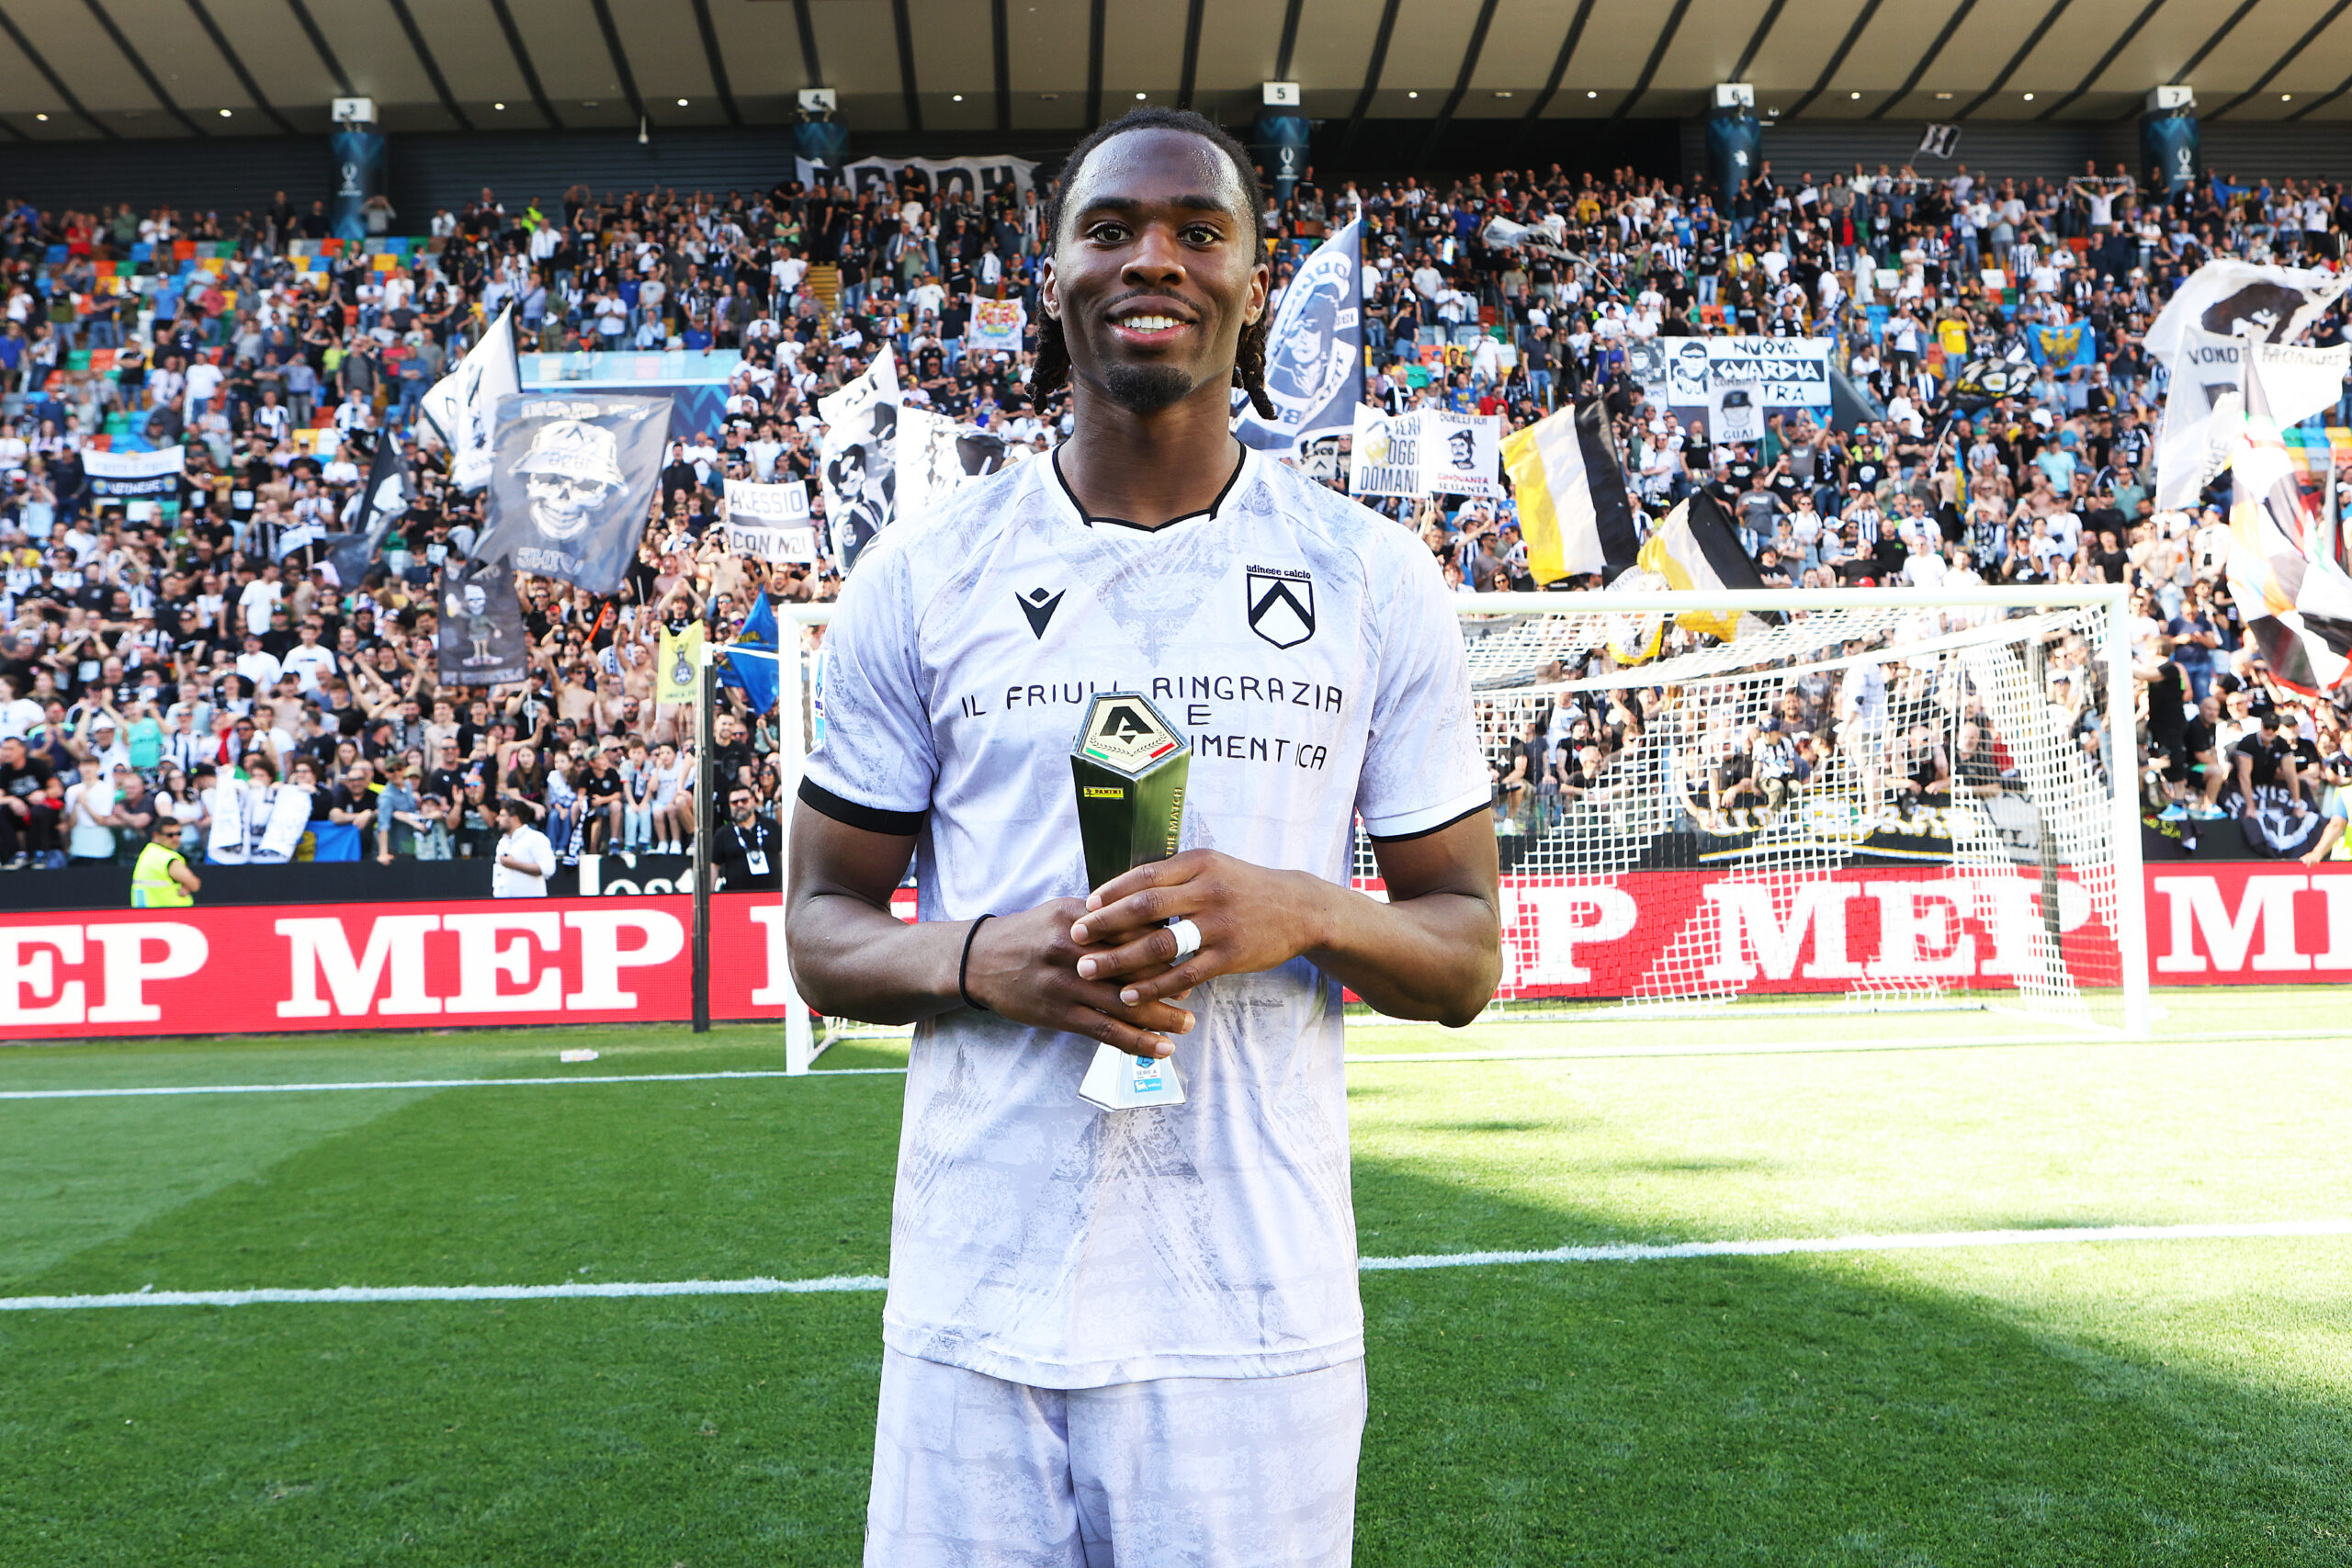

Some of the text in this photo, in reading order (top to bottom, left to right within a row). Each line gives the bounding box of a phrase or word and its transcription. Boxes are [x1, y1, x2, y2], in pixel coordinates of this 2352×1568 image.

[1277, 88, 1286, 100] 5
[1732, 89, 1740, 101] 6
[2172, 91, 2180, 103] 7
[1734, 339, 1800, 355] NUOVA
[1717, 359, 1821, 381] GUARDIA
[1761, 383, 1805, 401] TRA
[1723, 428, 1755, 441] GUAI
[1387, 439, 1420, 465] OGGI
[1360, 466, 1419, 494] DOMANI
[730, 490, 804, 514] ALESSIO
[733, 531, 806, 555] CON NOI
[1246, 564, 1311, 580] udinese calcio
[961, 675, 1343, 719] IL FRIU RINGRAZIA
[1187, 704, 1213, 726] E
[1191, 733, 1329, 771] IMENTICA
[1166, 787, 1183, 856] THE MATCH
[1702, 880, 2092, 981] MEP
[0, 921, 209, 1024] EP
[275, 908, 684, 1018] MEP
